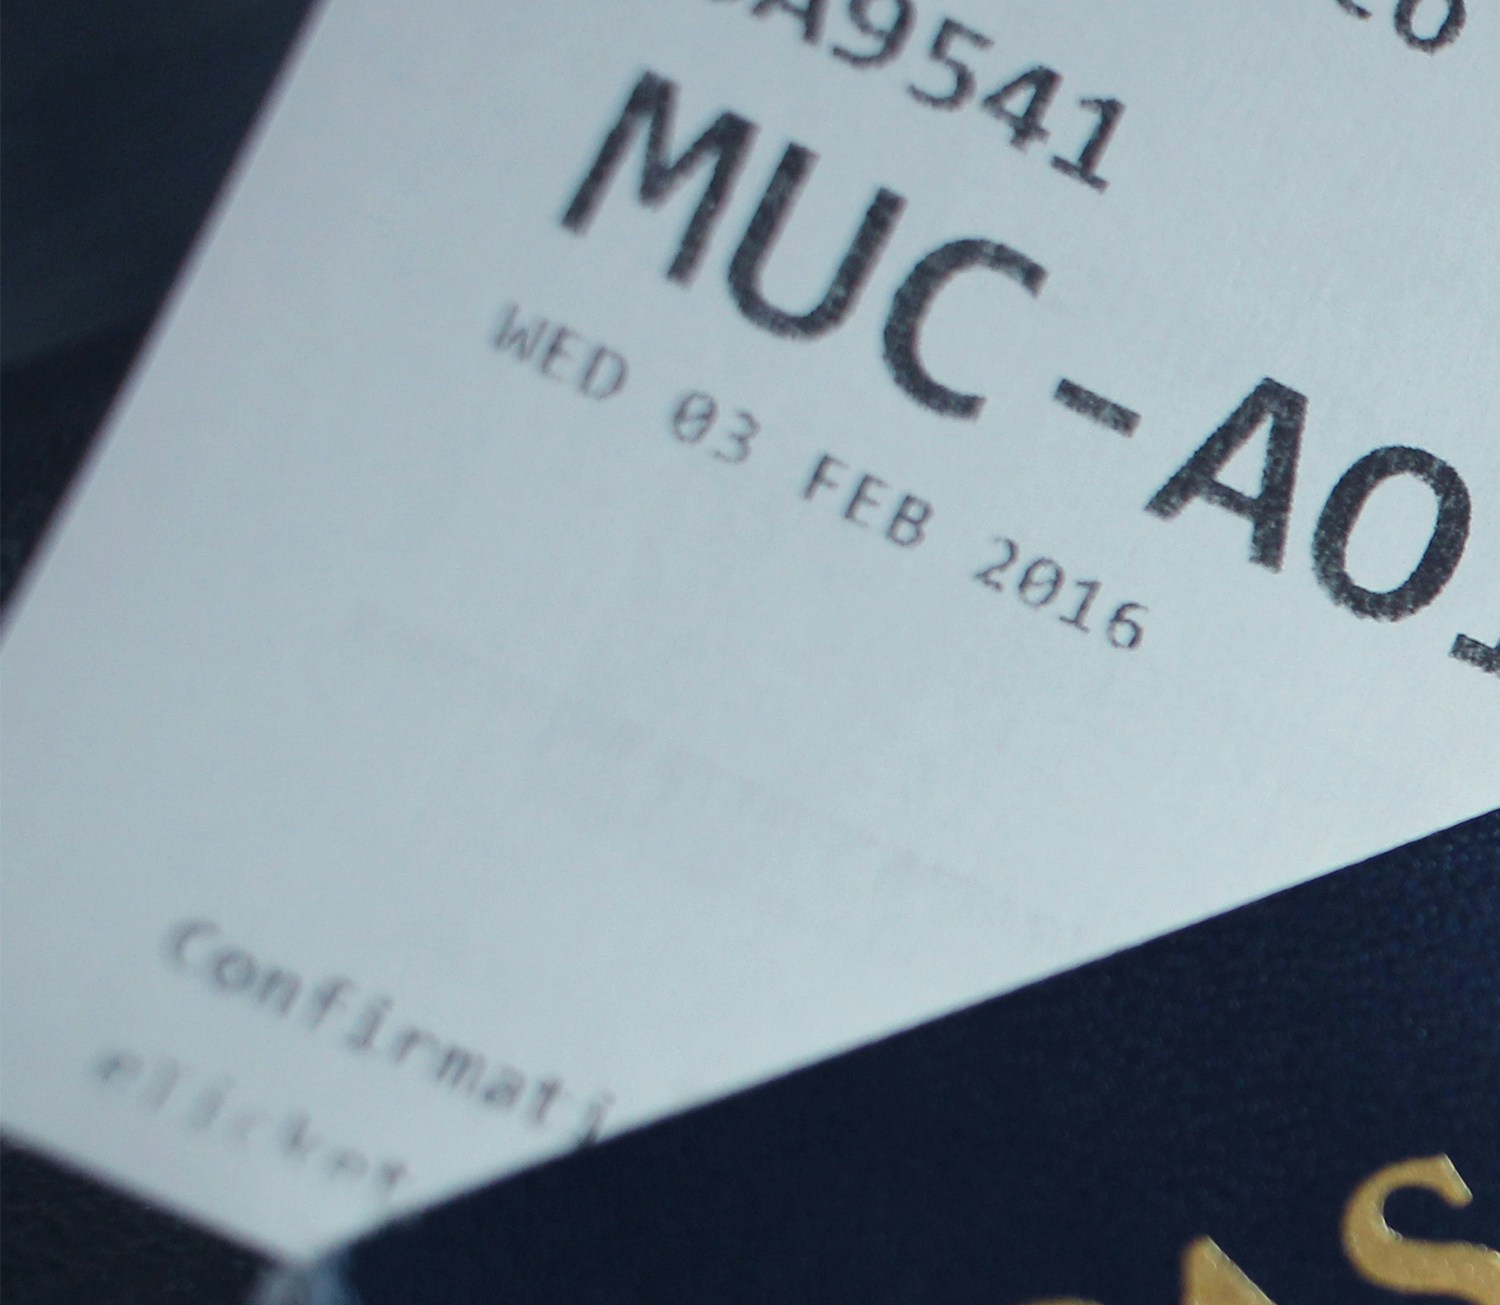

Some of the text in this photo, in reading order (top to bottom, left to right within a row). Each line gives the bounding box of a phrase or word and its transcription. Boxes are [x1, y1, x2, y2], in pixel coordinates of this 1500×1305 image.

[1336, 0, 1467, 54] o
[491, 303, 1149, 651] WED 03 FEB 2016
